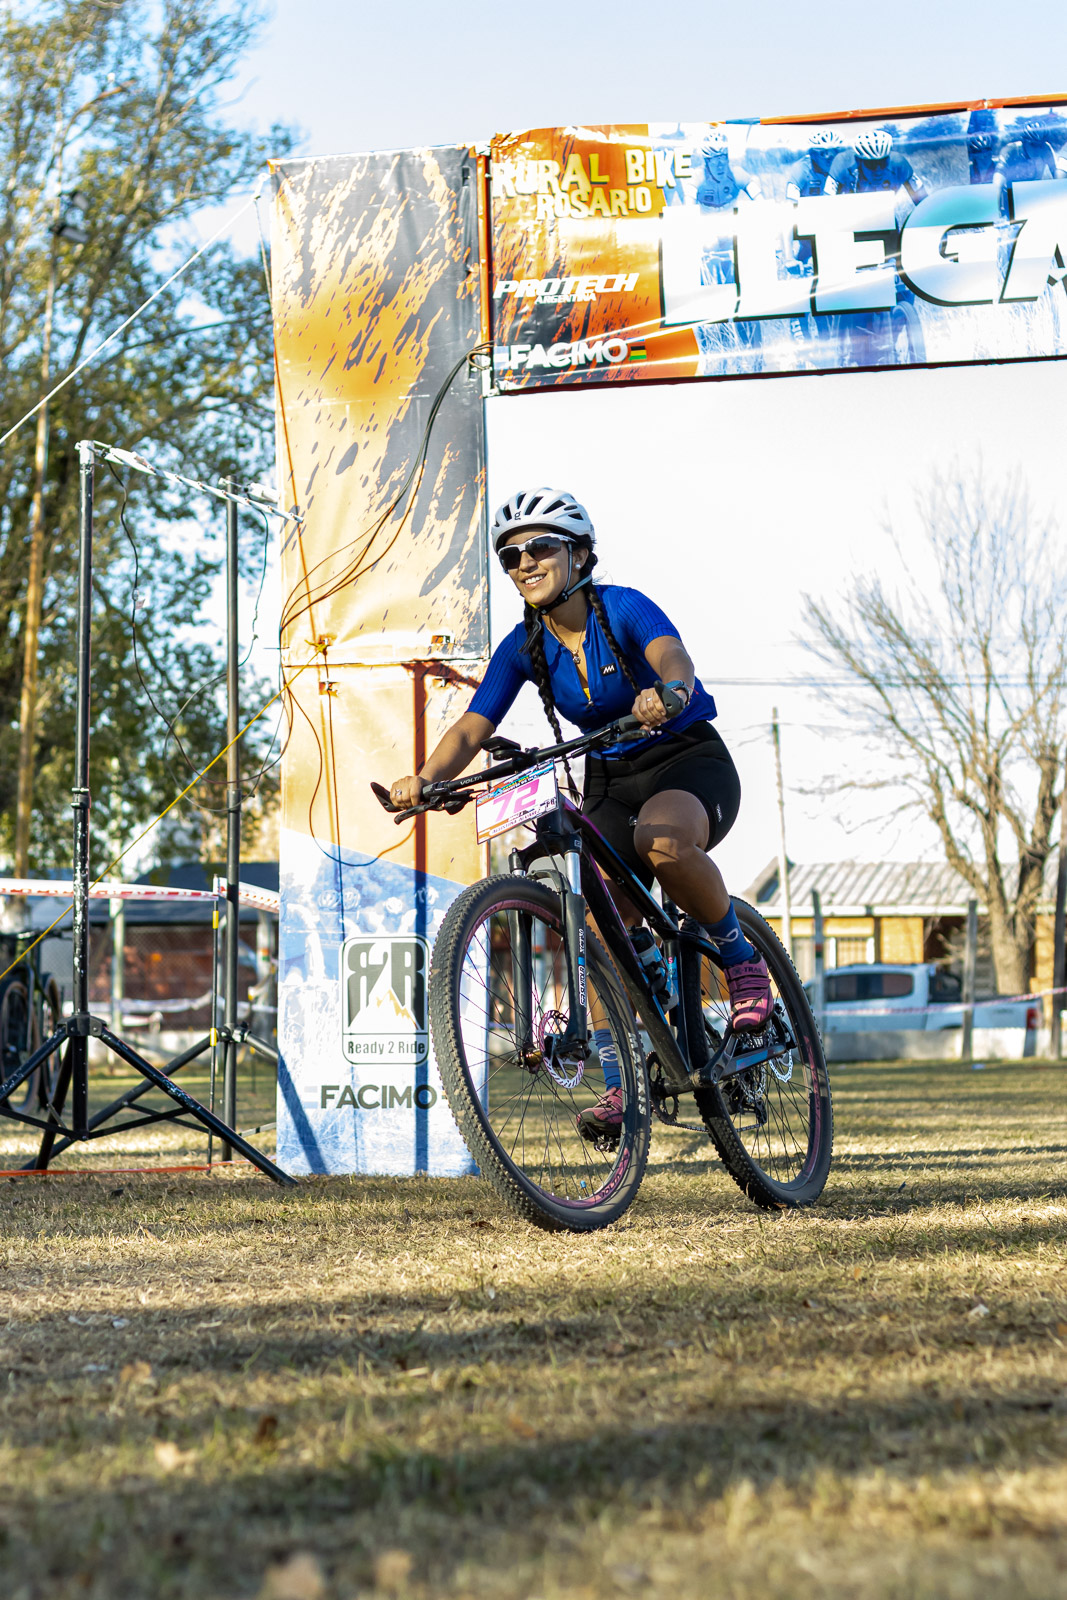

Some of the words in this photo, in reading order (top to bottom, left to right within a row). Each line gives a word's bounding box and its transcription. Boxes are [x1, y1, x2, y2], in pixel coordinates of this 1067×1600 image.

[491, 153, 610, 198] RURAL
[625, 149, 692, 188] BIKE
[537, 186, 652, 220] ROSARIO
[493, 273, 640, 299] PROTECH
[534, 290, 597, 304] ARGENTINA
[510, 338, 628, 370] FACIMO
[460, 775, 482, 786] VOLTA
[493, 778, 540, 822] 72
[348, 1041, 384, 1055] Ready
[388, 1041, 394, 1054] 2
[398, 1041, 425, 1054] Ride
[628, 1032, 647, 1116] MAXXIS
[320, 1084, 438, 1110] FACIMO
